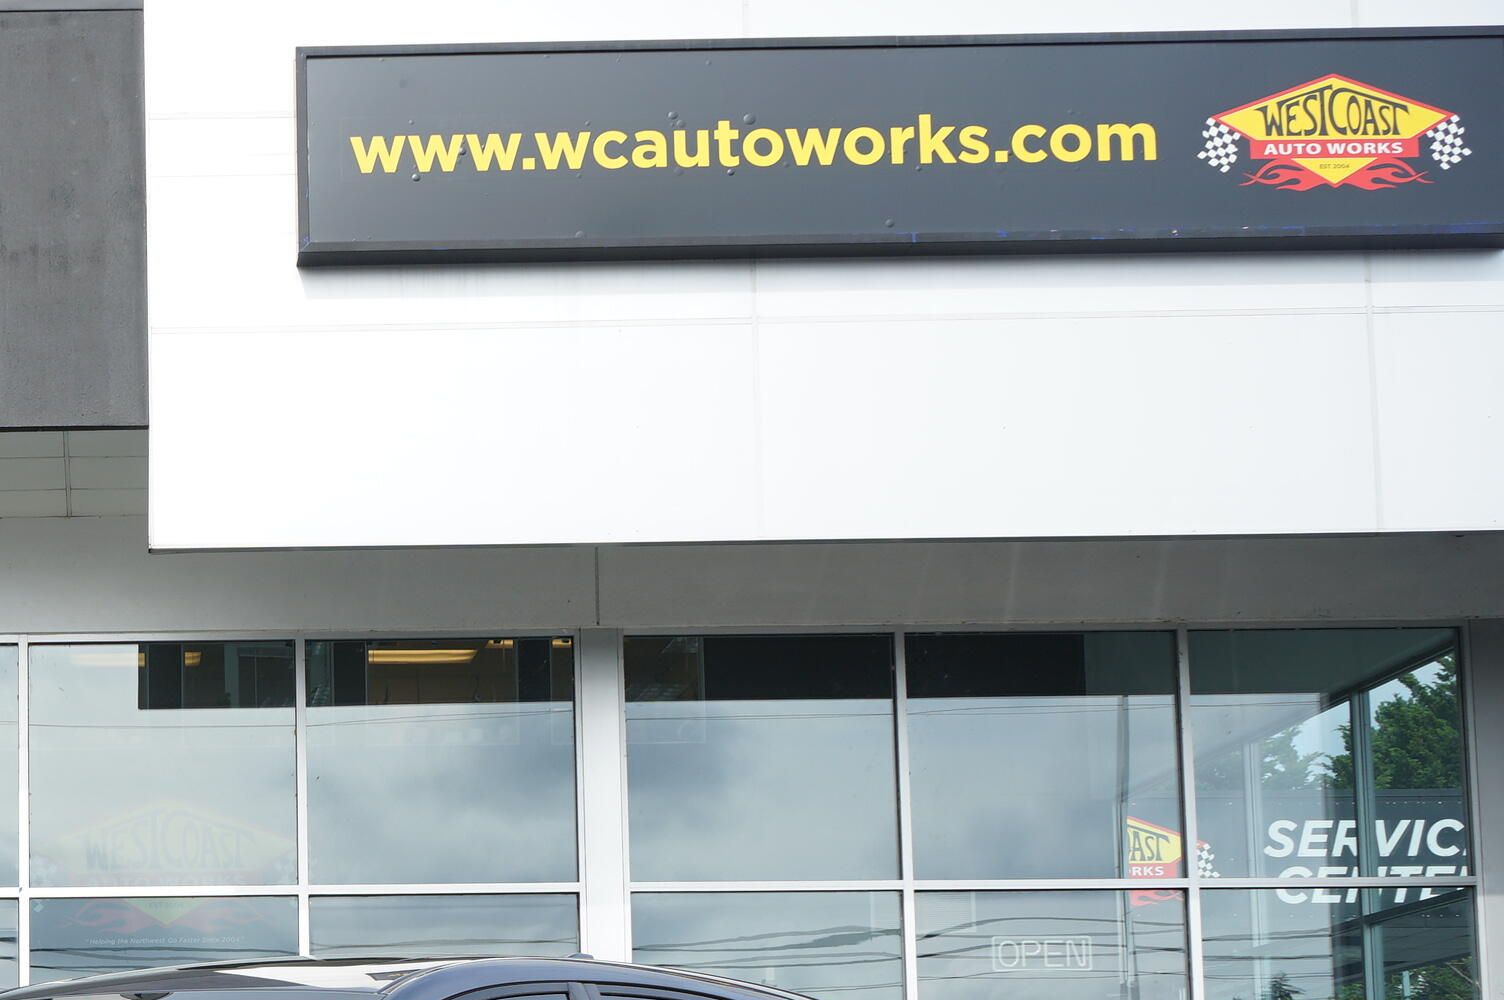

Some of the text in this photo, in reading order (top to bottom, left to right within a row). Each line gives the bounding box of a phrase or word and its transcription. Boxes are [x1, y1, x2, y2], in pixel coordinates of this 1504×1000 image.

[349, 113, 1158, 175] www.wcautoworks.com
[1264, 141, 1404, 156] AUTO WORKS
[1263, 818, 1467, 859] SERVIC
[998, 940, 1086, 968] OPEN
